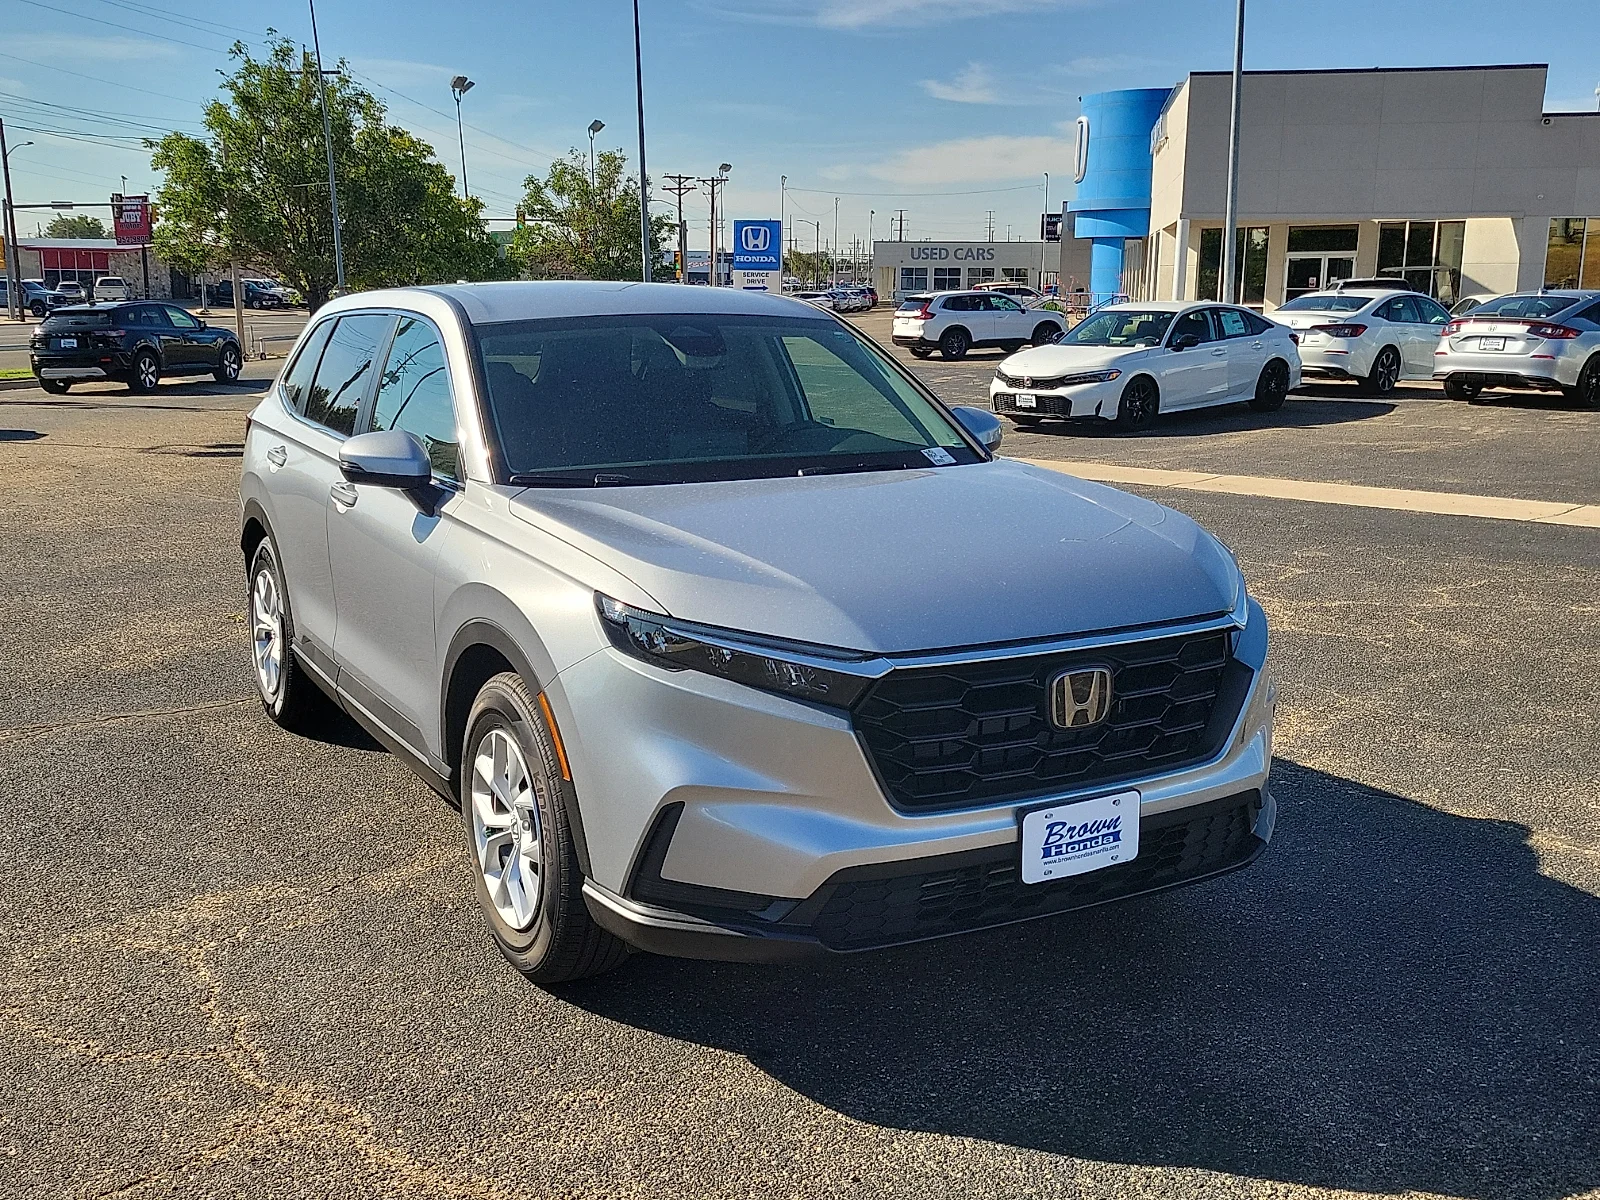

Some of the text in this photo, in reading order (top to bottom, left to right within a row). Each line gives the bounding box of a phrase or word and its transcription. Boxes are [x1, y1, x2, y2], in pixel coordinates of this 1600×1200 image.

[735, 255, 777, 263] HONDA
[910, 247, 995, 261] USED CARS
[1042, 815, 1122, 846] Brown
[1050, 835, 1114, 856] Honda
